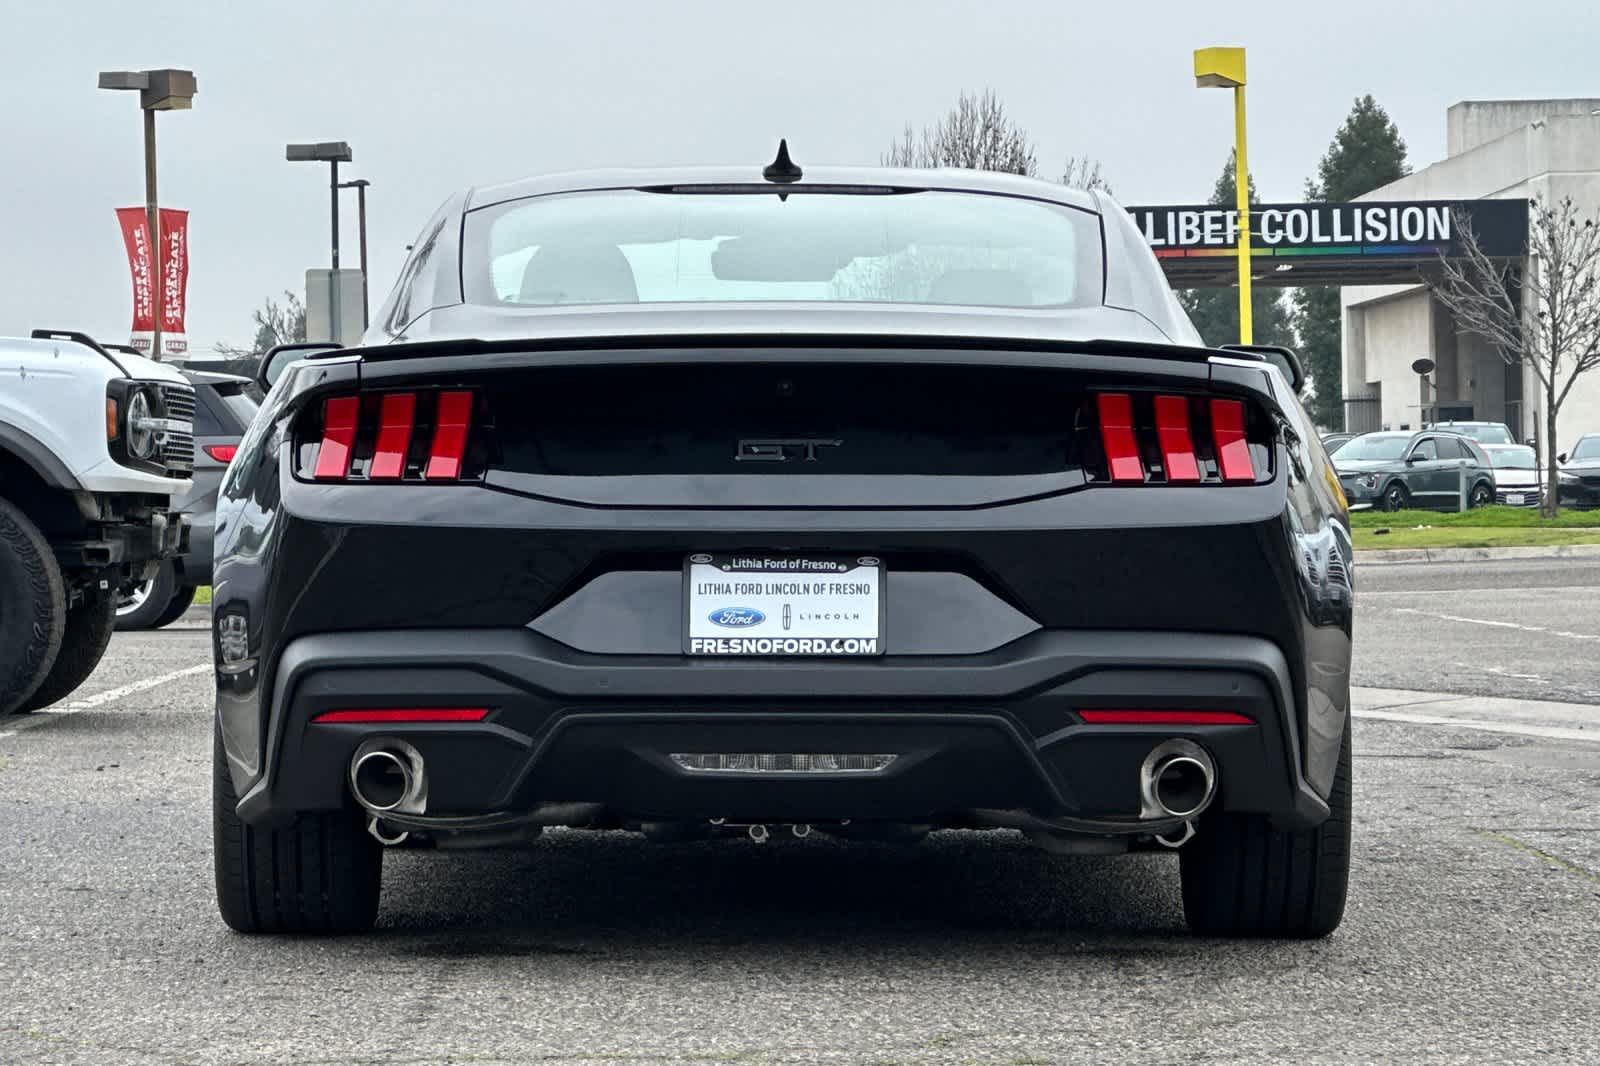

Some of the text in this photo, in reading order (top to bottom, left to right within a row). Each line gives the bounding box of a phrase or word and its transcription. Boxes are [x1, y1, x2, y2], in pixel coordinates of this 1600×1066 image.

[1260, 206, 1451, 244] COLLISION
[735, 439, 843, 460] GT
[732, 558, 837, 570] Lithia Ford of Fresno
[698, 583, 871, 595] LITHIA FORD LINCOLN OF FRESNO
[719, 609, 754, 626] Ford
[799, 613, 860, 621] LINCOLN
[691, 639, 877, 654] FRESNOFORD.COM
